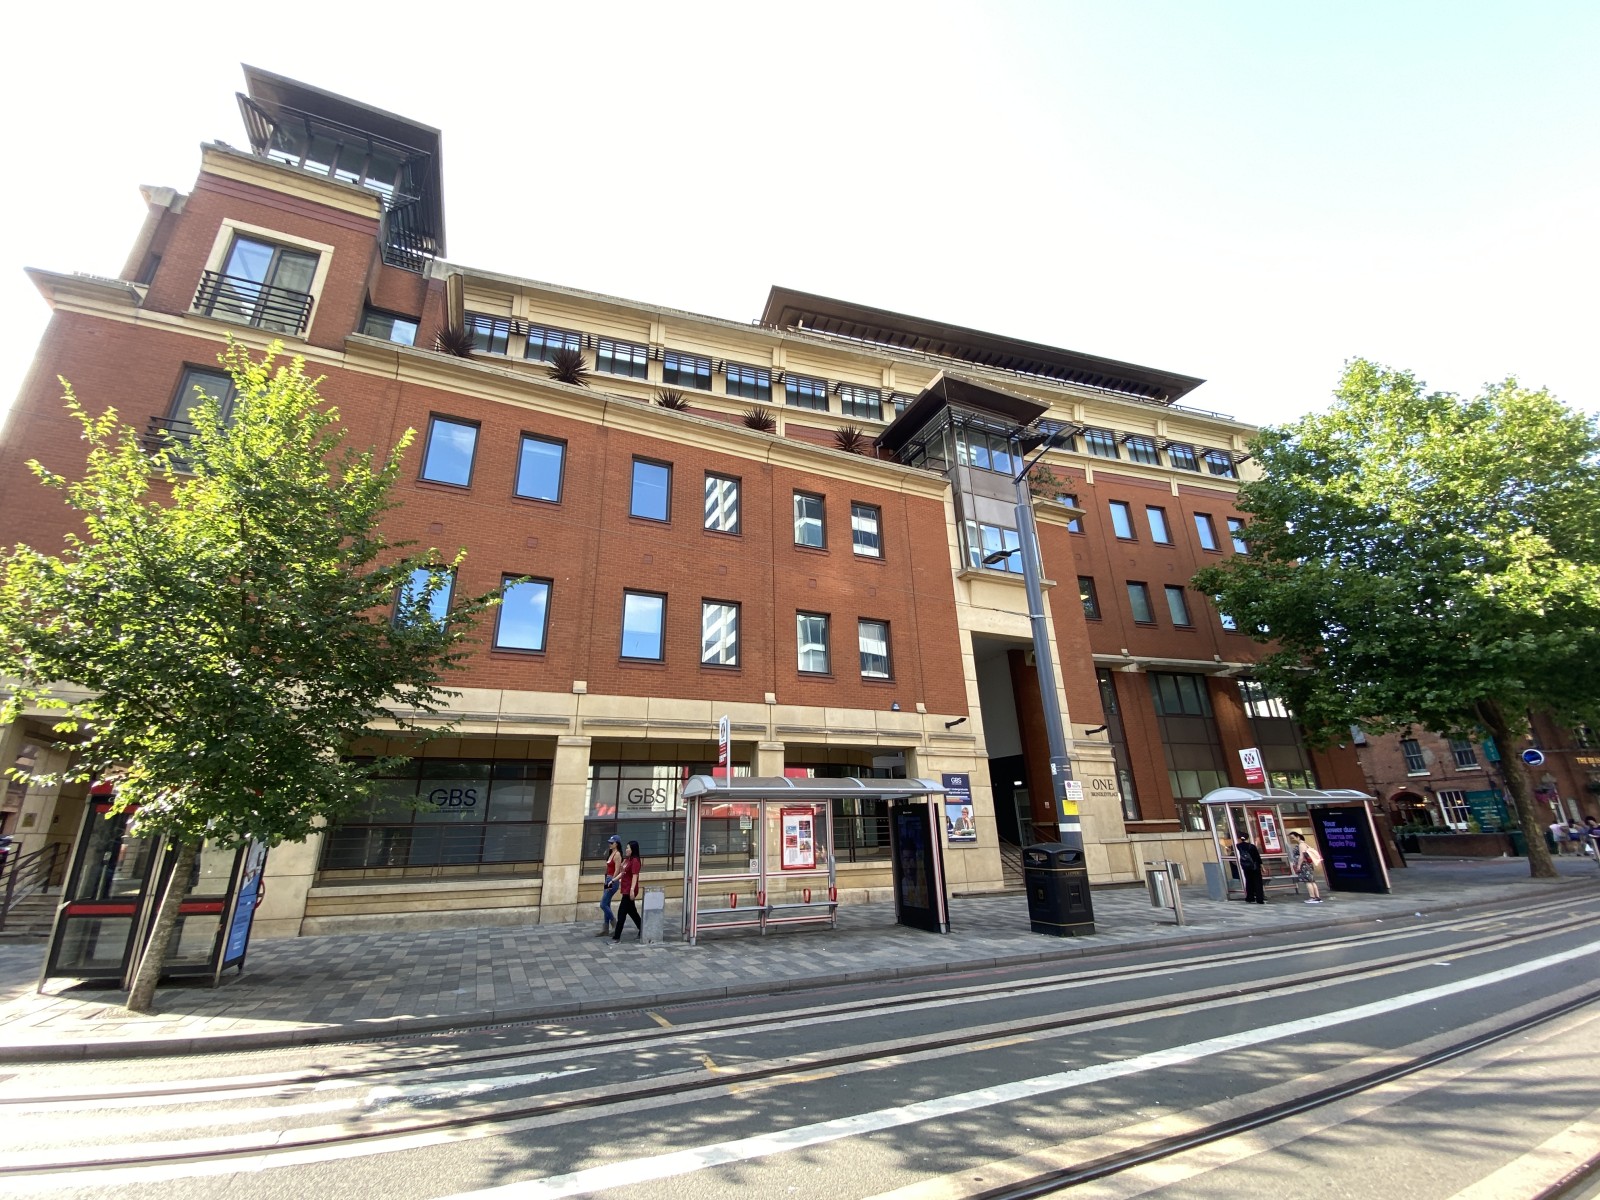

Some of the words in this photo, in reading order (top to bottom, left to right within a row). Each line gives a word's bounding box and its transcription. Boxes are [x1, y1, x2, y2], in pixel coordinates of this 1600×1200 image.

[1092, 778, 1115, 791] ONE
[429, 788, 477, 807] GBS
[628, 788, 666, 804] GBS
